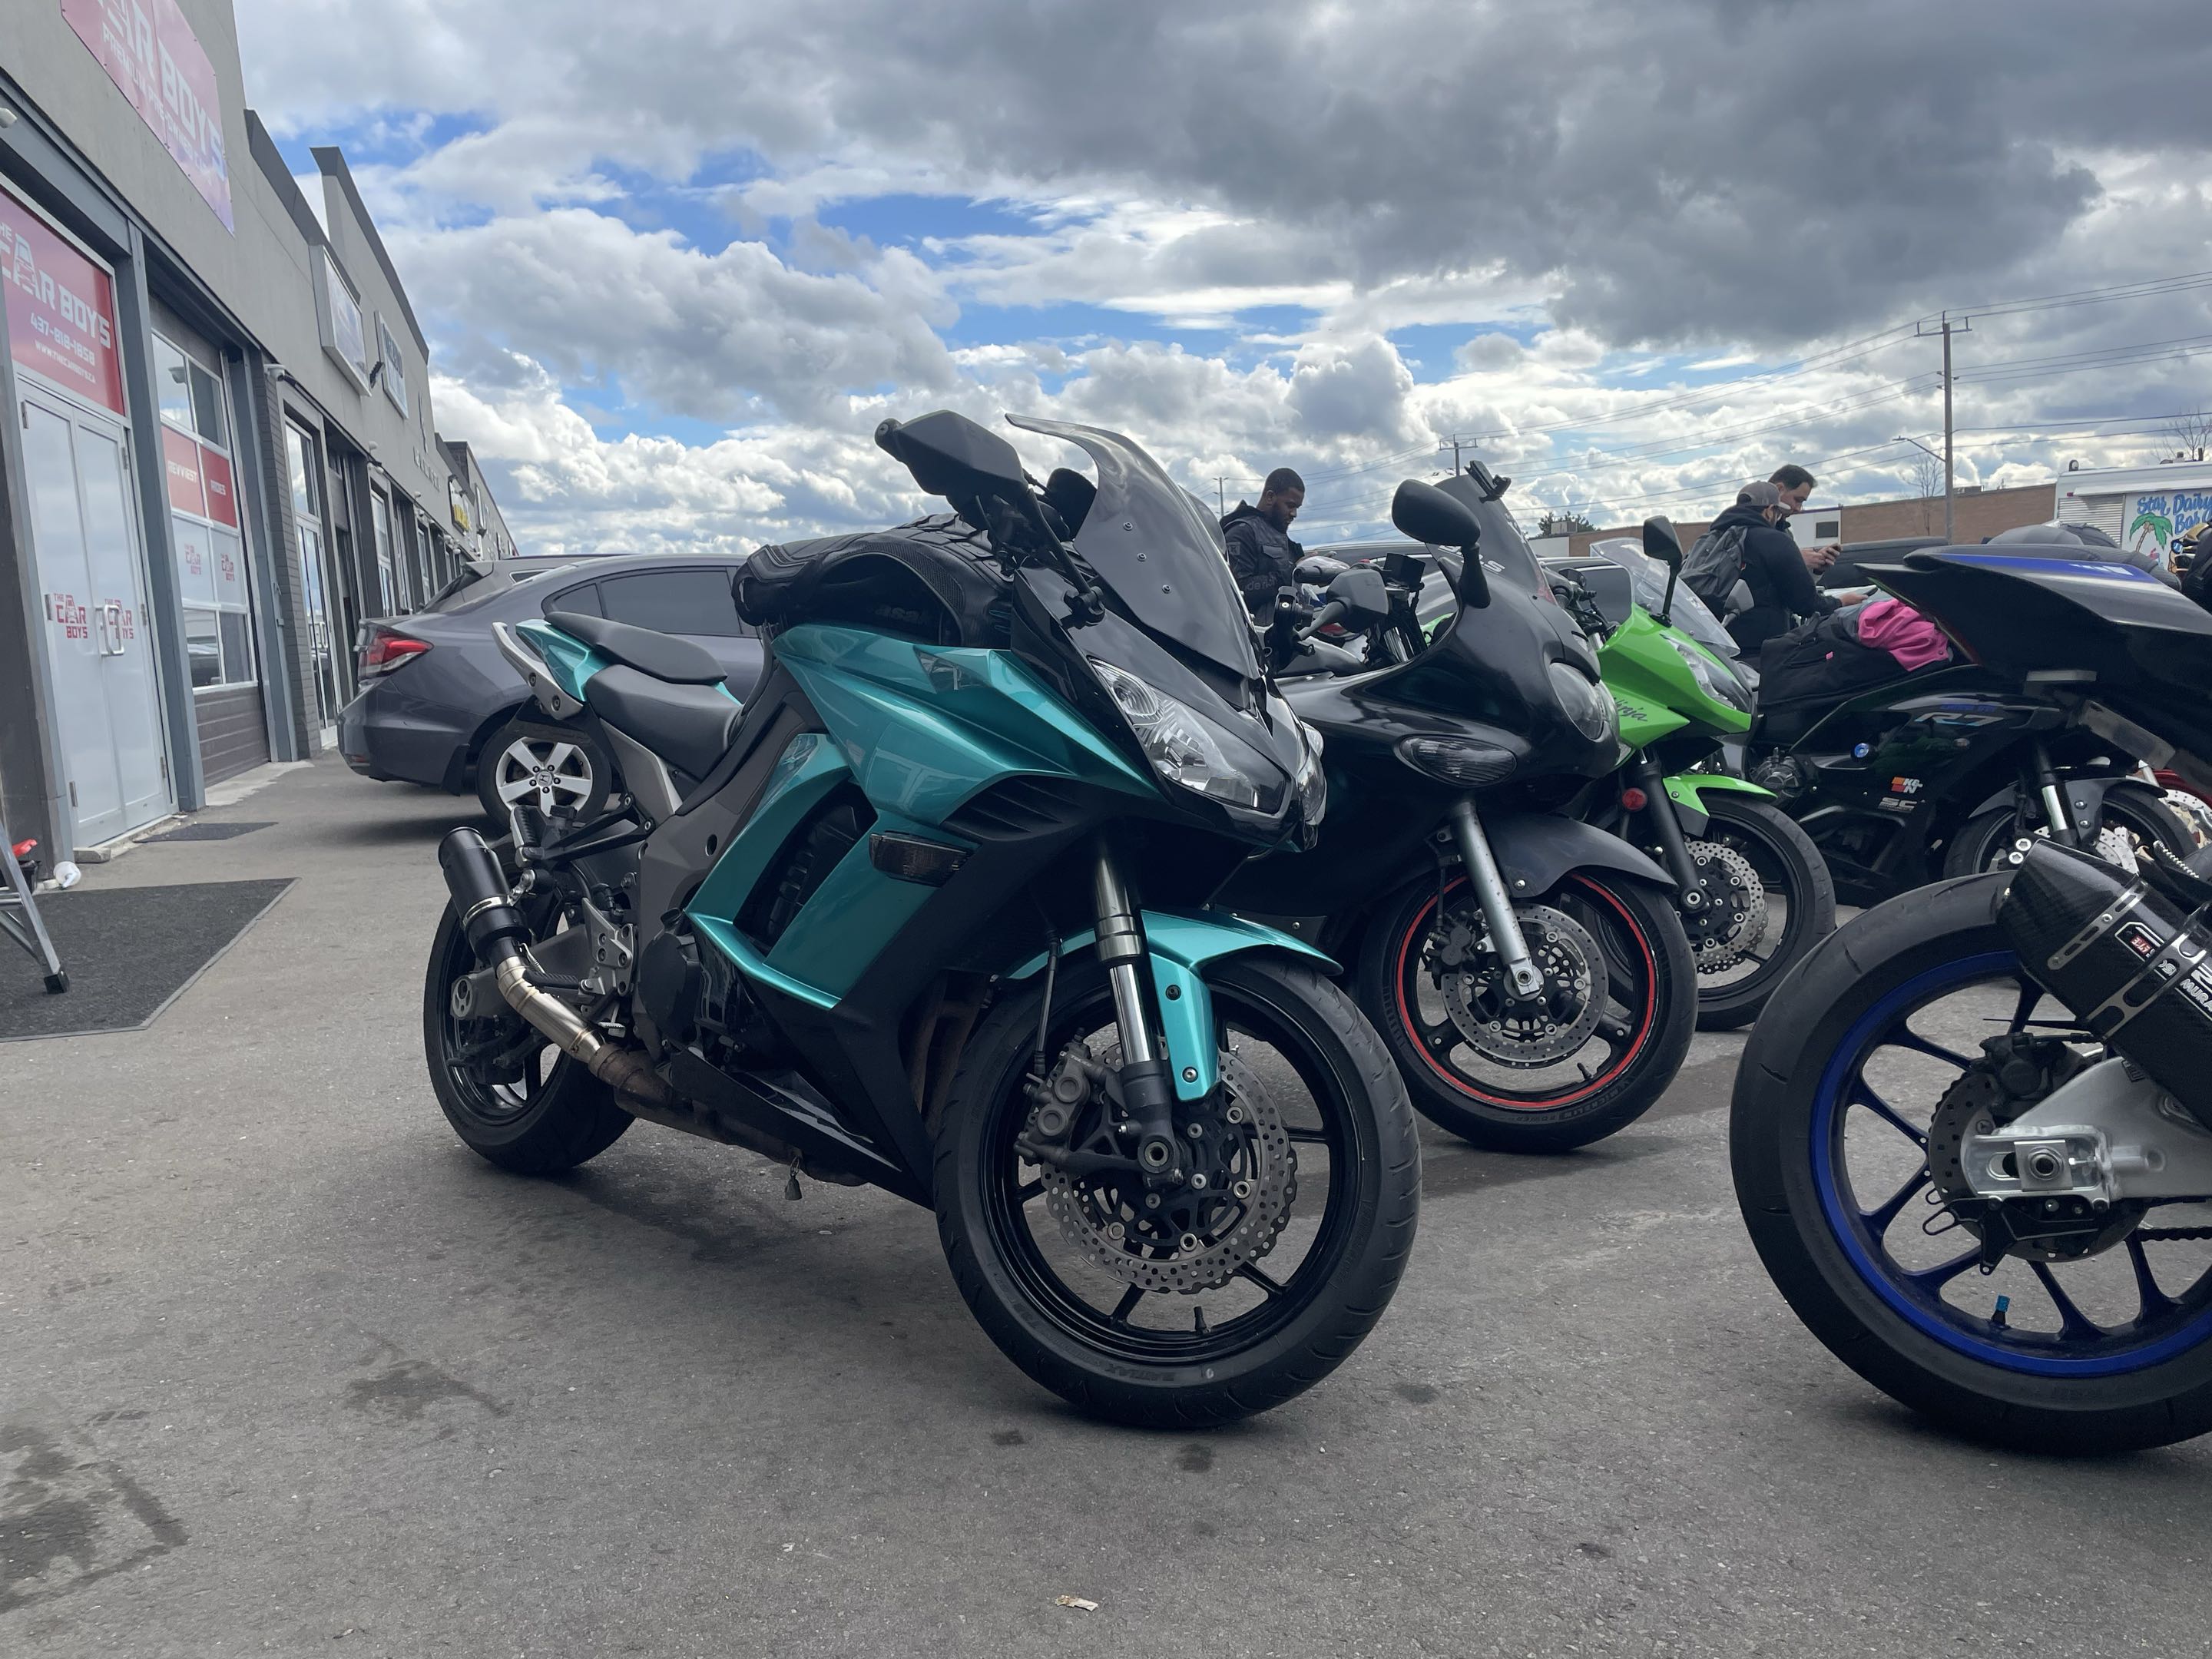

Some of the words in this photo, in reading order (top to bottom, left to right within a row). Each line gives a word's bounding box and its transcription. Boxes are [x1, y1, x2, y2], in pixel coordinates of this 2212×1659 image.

[158, 38, 225, 181] BOYS
[58, 284, 111, 349] BOYS
[54, 593, 65, 602] THE
[55, 594, 87, 624] CAR
[66, 625, 88, 639] BOYS
[1614, 697, 1648, 721] inja
[1914, 711, 2004, 727] R7
